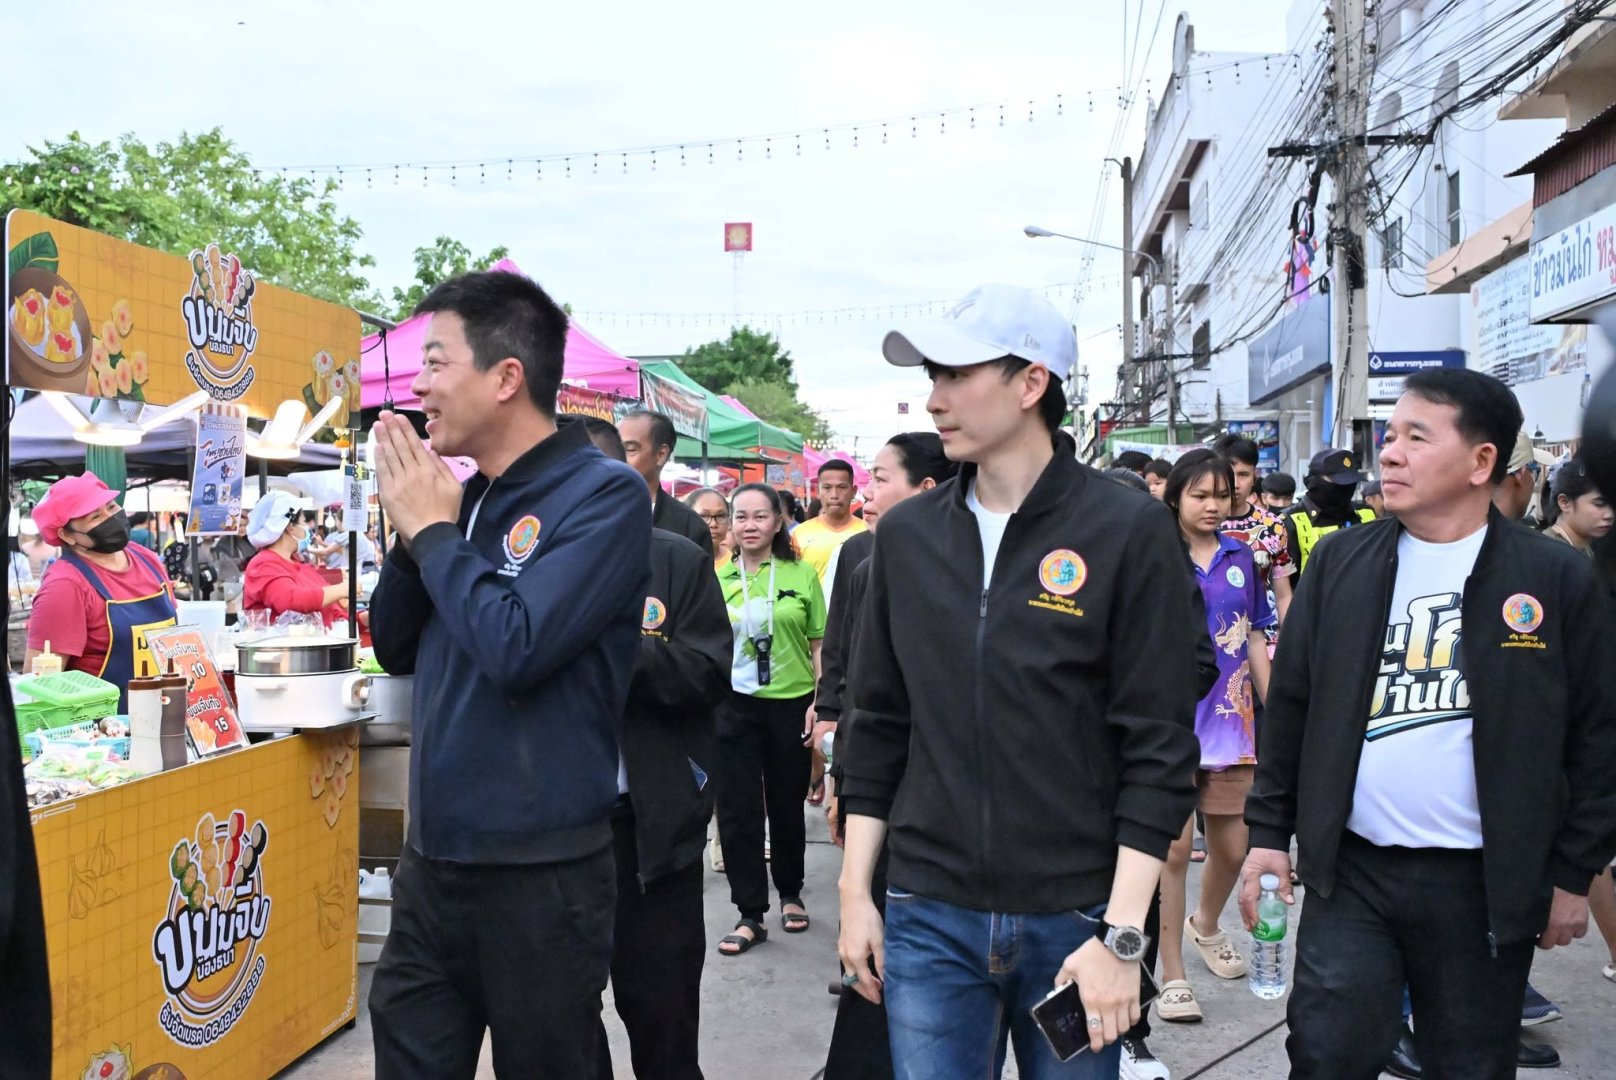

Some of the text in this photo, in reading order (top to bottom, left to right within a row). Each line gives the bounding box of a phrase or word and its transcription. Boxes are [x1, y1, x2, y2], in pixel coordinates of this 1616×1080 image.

[1534, 222, 1592, 297] ข้าวมันไก่
[184, 297, 257, 351] ขนมจีบ
[214, 368, 254, 400] 0648432888
[192, 661, 207, 679] 10
[214, 716, 229, 733] 15
[156, 880, 269, 992] ขนมจีบ
[160, 1003, 203, 1045] รับจัดเบรค
[203, 956, 264, 1043] 0648432888
